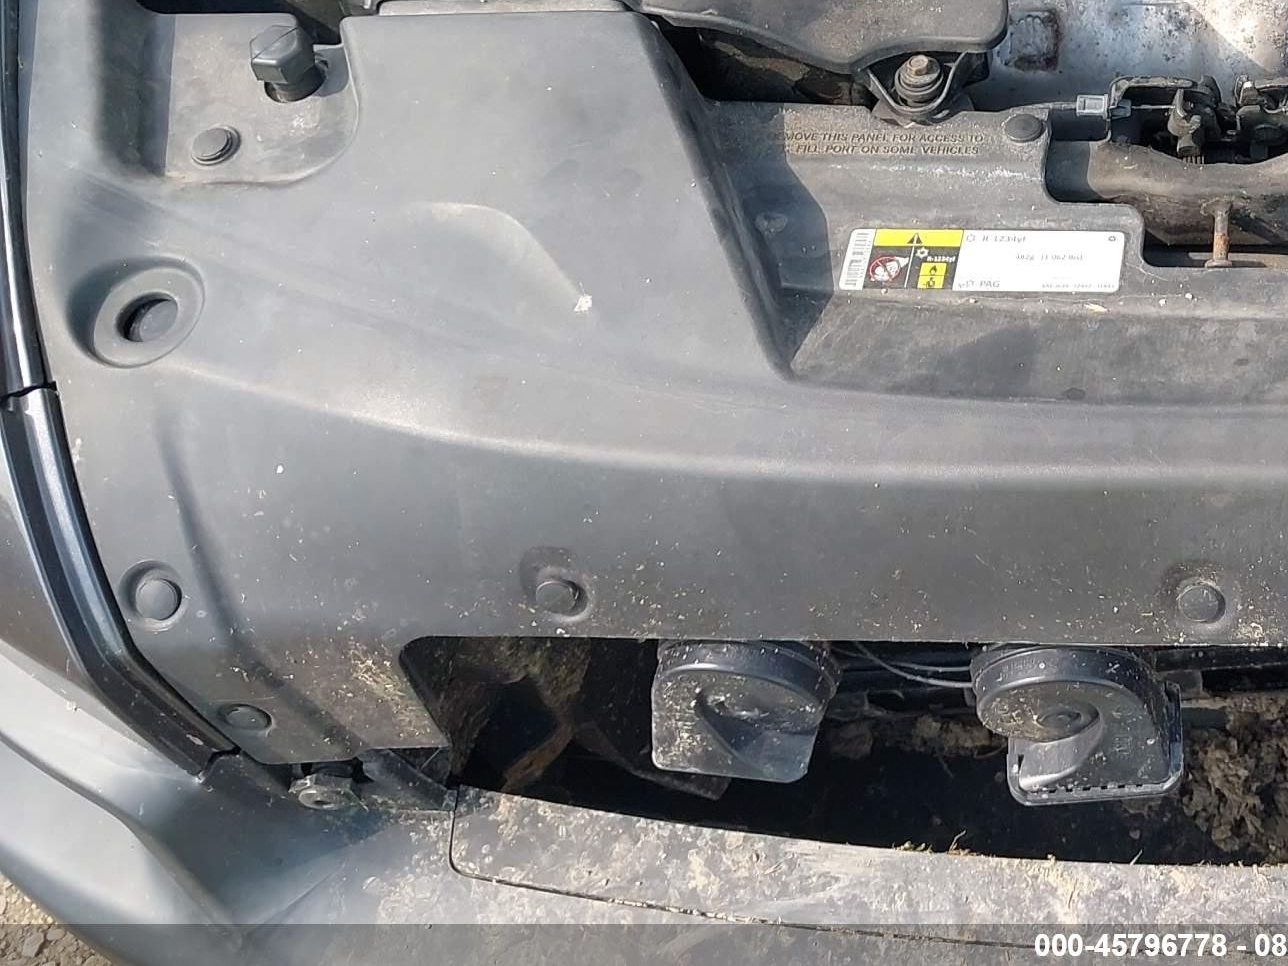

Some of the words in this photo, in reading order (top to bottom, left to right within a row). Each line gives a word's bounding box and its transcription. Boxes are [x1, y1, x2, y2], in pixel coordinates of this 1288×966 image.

[822, 132, 848, 142] THIS
[851, 133, 887, 143] PANEL
[892, 133, 915, 143] FOR
[919, 133, 965, 143] ACCESS
[969, 133, 984, 143] TO
[796, 145, 819, 153] FILL
[825, 145, 857, 153] PORT
[861, 145, 879, 154] ON
[883, 145, 917, 154] SOME
[921, 145, 979, 155] VEHICLES
[980, 280, 1001, 288] PAG
